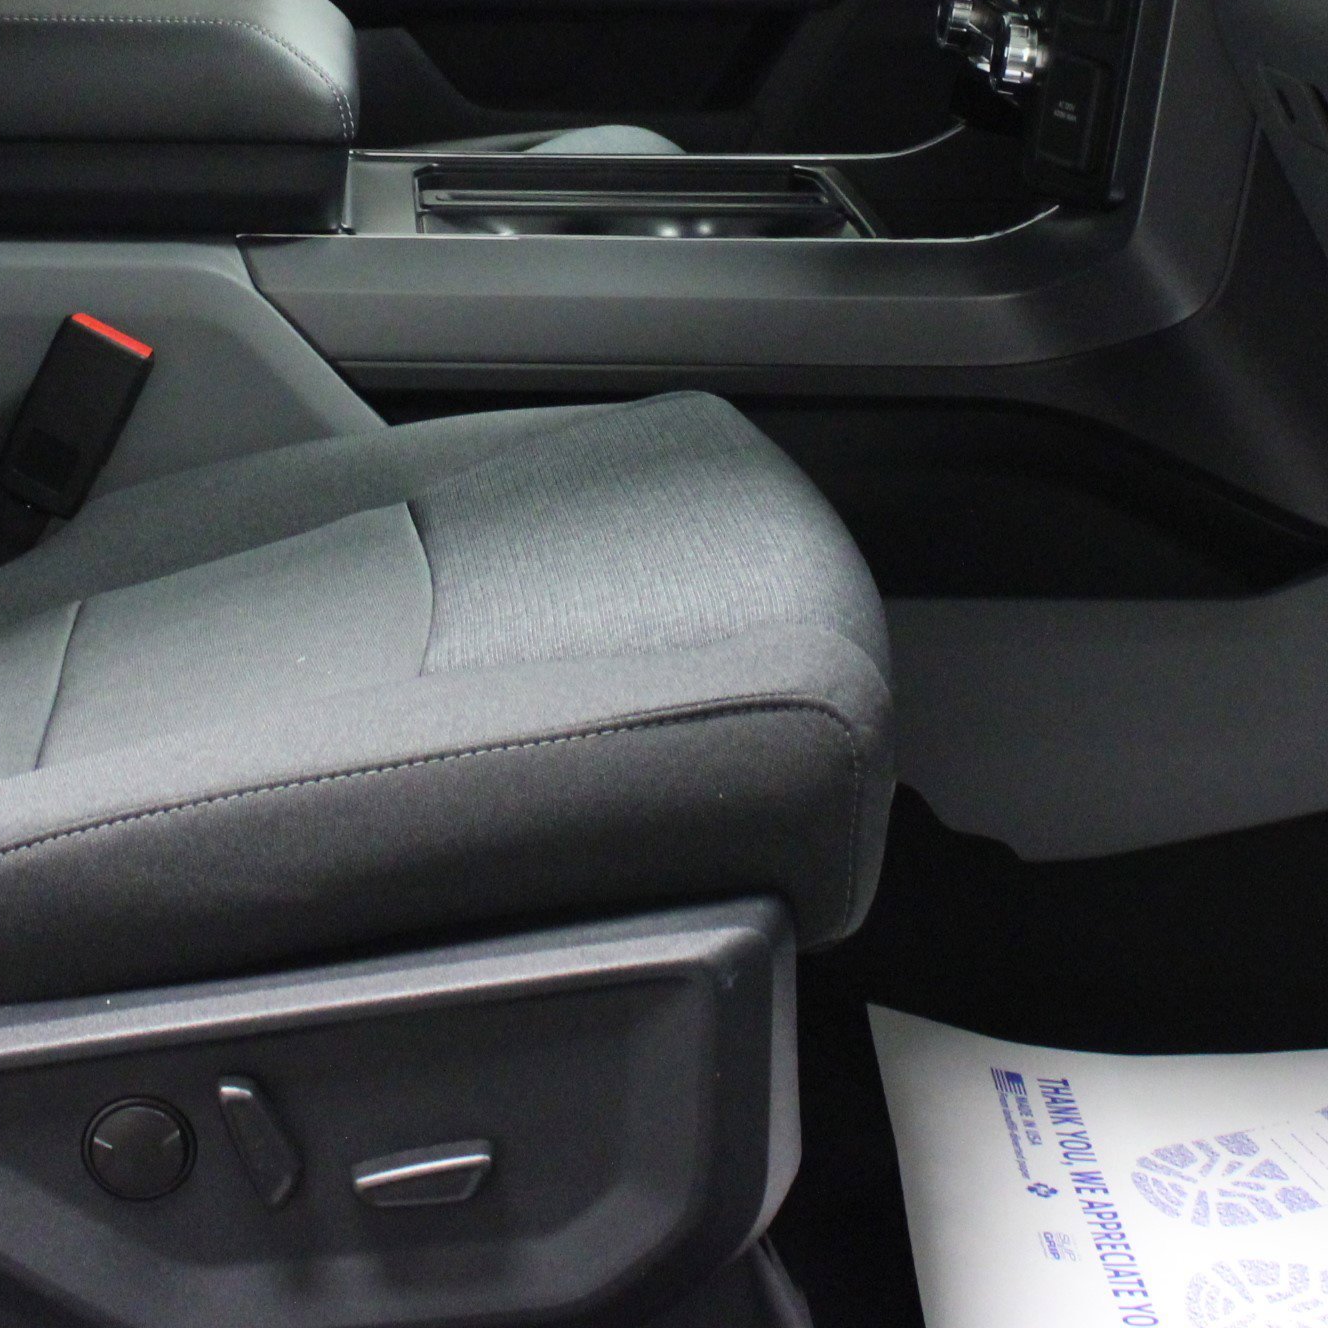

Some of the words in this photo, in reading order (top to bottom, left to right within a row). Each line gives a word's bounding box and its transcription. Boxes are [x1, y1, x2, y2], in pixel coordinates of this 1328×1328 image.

[1015, 1095, 1033, 1118] MADE
[1026, 1129, 1043, 1145] USA
[1036, 1077, 1085, 1127] THANK
[1055, 1129, 1098, 1166] YOU,
[1069, 1170, 1110, 1195] WE
[1043, 1231, 1060, 1260] GRIP
[1078, 1198, 1149, 1298] APPRECIATE
